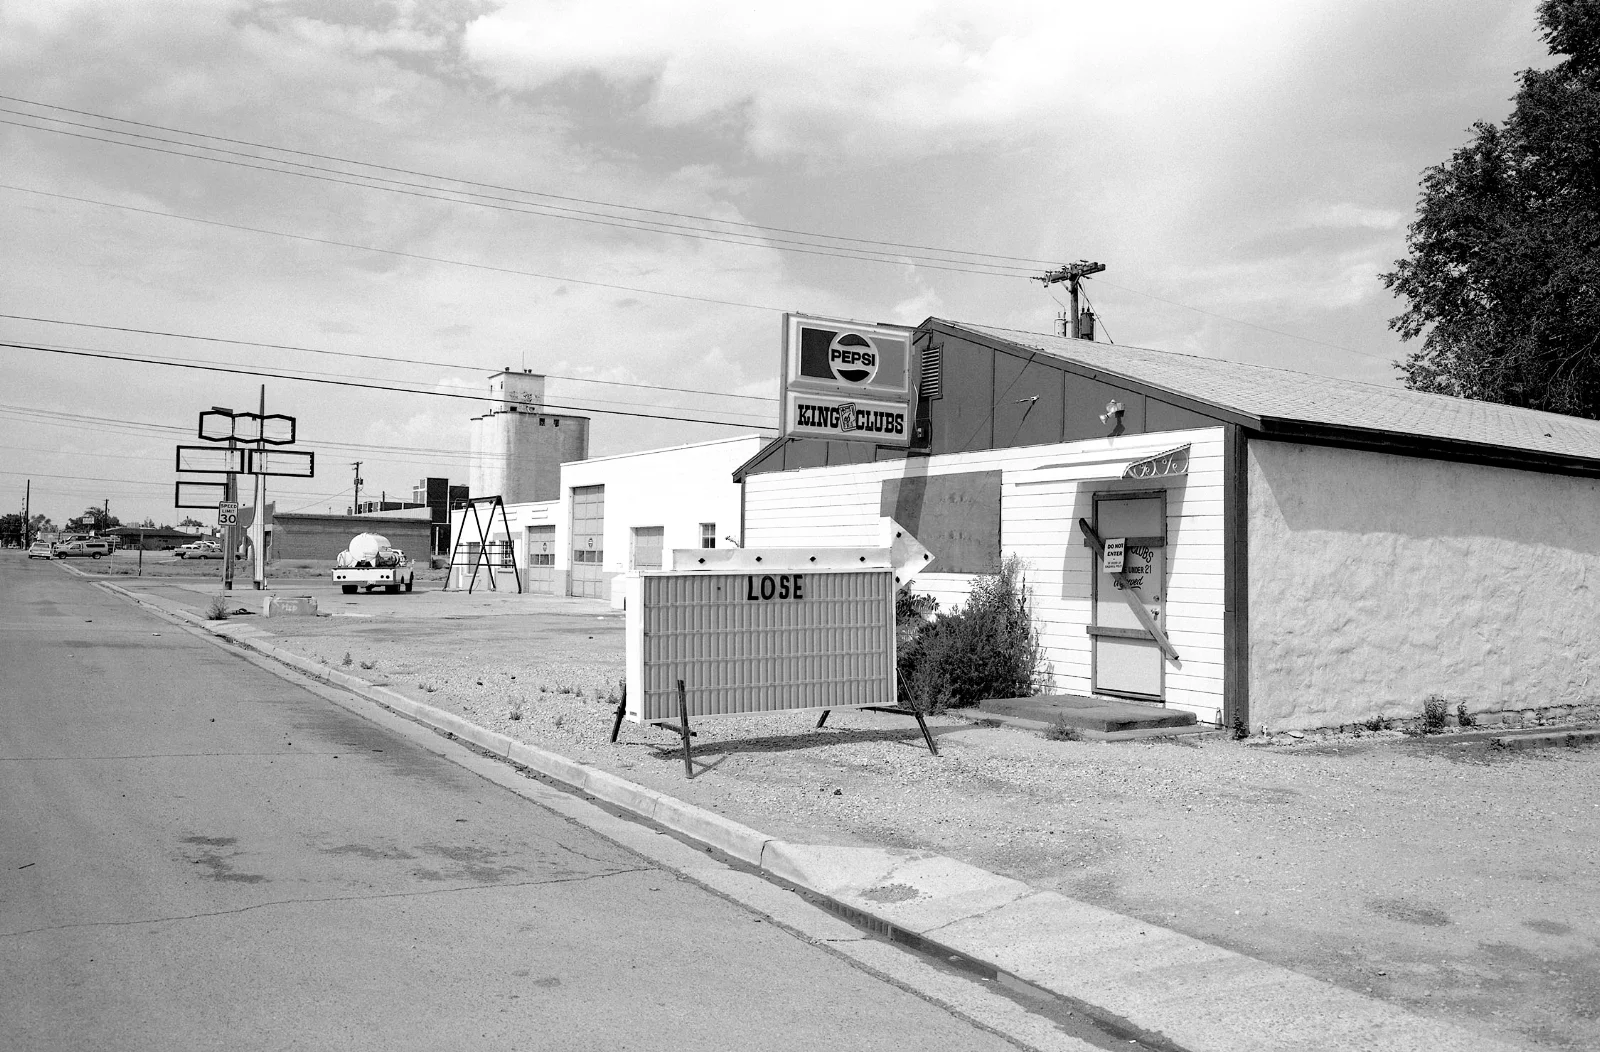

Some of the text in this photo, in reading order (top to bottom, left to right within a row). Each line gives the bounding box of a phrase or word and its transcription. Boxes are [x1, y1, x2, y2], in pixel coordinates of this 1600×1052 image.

[830, 348, 876, 366] PEPSI
[797, 404, 840, 429] KING
[855, 409, 904, 435] CLUBS
[220, 514, 236, 523] 30
[1145, 564, 1152, 574] 21
[747, 574, 803, 600] LOSE
